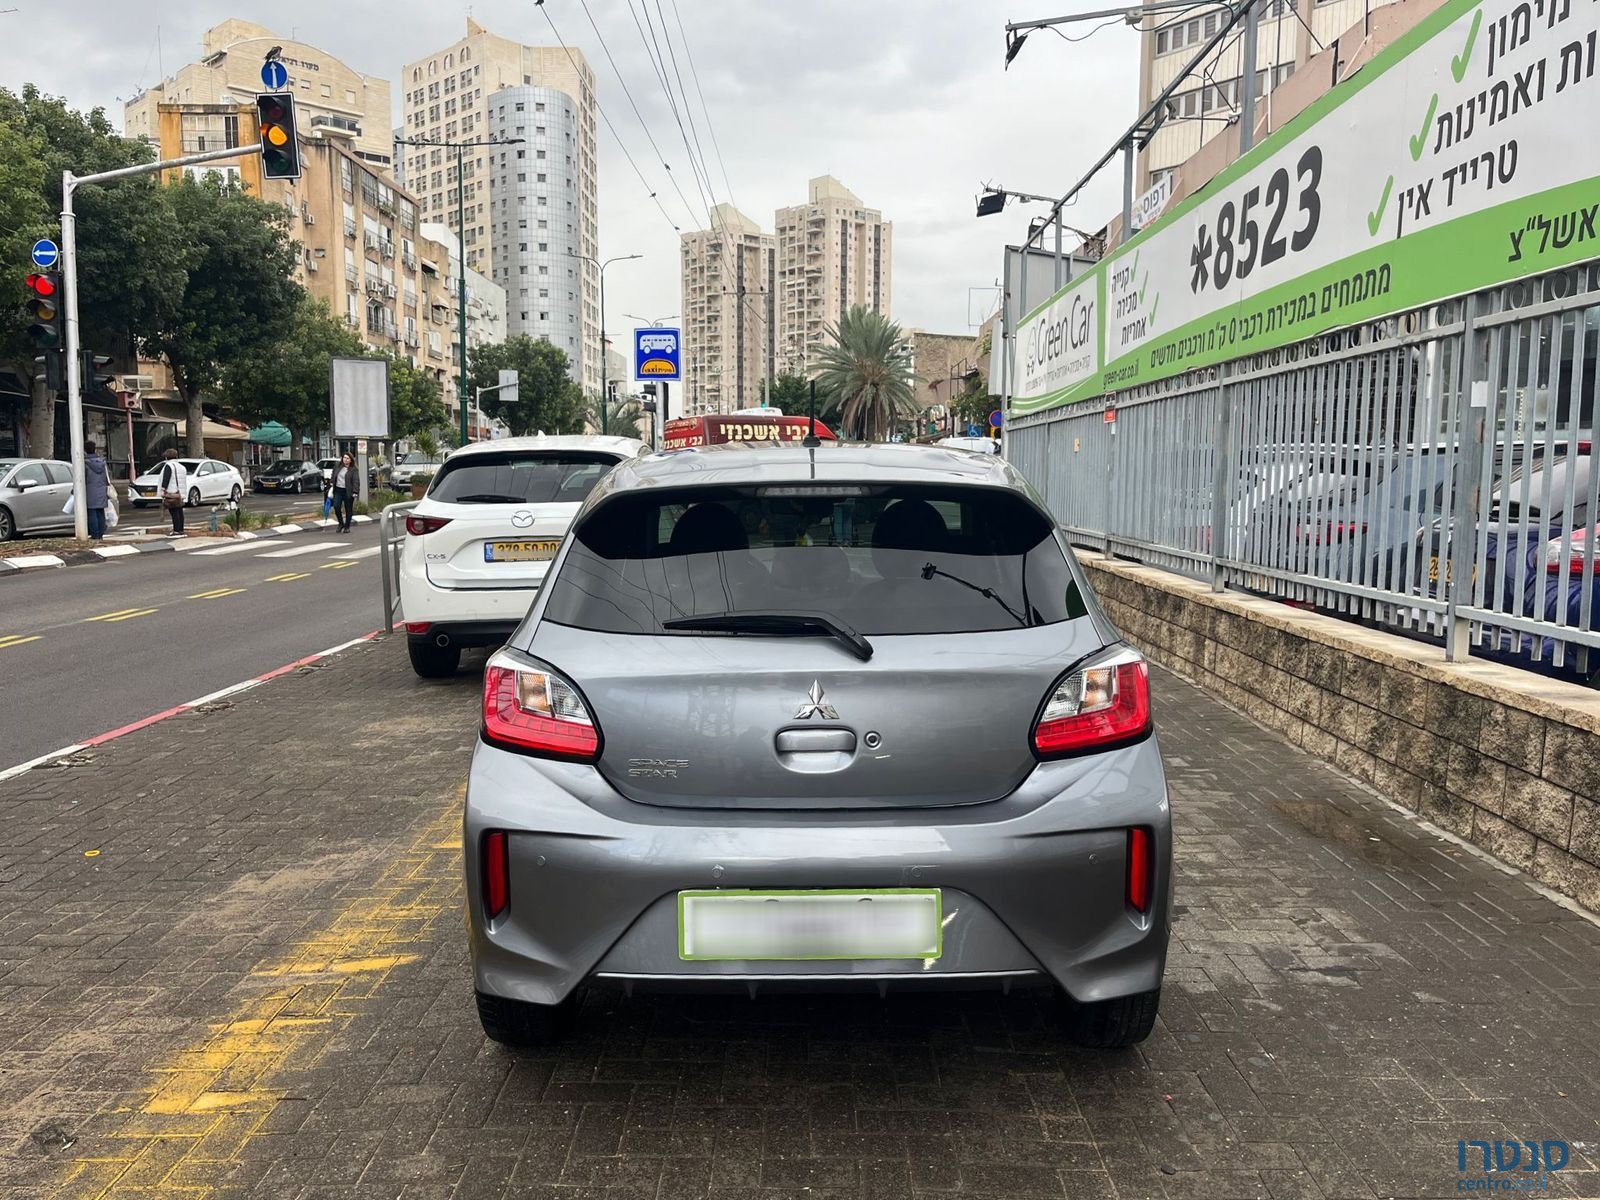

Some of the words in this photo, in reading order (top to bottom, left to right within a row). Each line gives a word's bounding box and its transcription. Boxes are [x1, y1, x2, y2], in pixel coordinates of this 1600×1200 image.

[1433, 57, 1547, 154] ואמינות
[1442, 139, 1518, 207] טרייד
[1143, 182, 1166, 214] דפוס
[1396, 178, 1434, 239] אין
[1112, 266, 1130, 294] קנייה
[1320, 263, 1391, 314] מתמחים
[1116, 291, 1138, 320] מכירה
[1265, 291, 1316, 333] במכירת
[1037, 316, 1068, 366] Green
[1070, 294, 1094, 350] Car
[1121, 316, 1147, 346] אחריות
[1239, 312, 1263, 341] רכבי
[1150, 343, 1176, 369] חדשים
[1178, 332, 1206, 360] ורכבים
[689, 435, 703, 446] גבי
[719, 423, 781, 441] אשכנזי
[785, 424, 810, 441] גבי
[627, 758, 689, 768] SPACE
[627, 768, 678, 778] STAR
